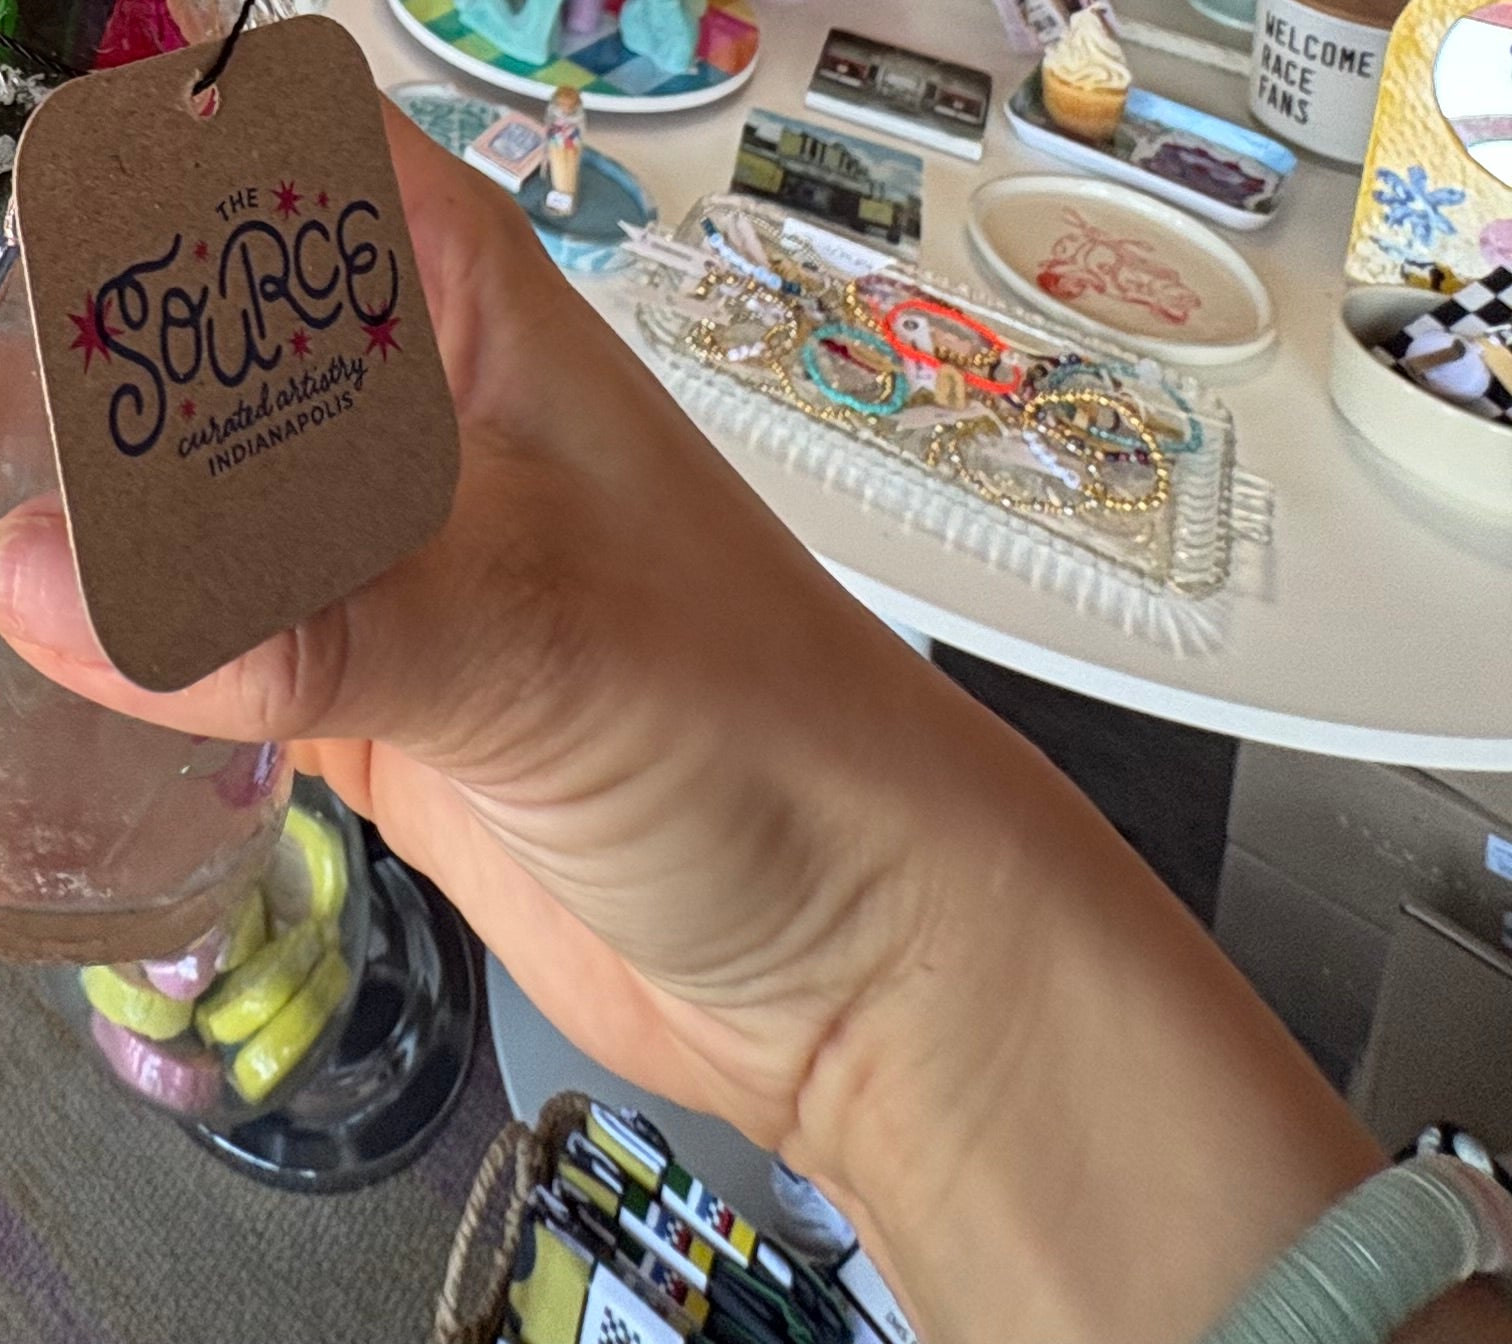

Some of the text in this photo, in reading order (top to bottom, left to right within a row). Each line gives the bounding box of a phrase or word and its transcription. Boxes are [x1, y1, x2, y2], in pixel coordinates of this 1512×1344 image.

[1260, 43, 1314, 96] RACE
[1264, 9, 1376, 80] WELCOME
[1257, 75, 1310, 127] FANS
[215, 187, 260, 223] THE
[177, 354, 368, 458] curated artistry
[207, 390, 355, 478] INDIANAPOLIS
